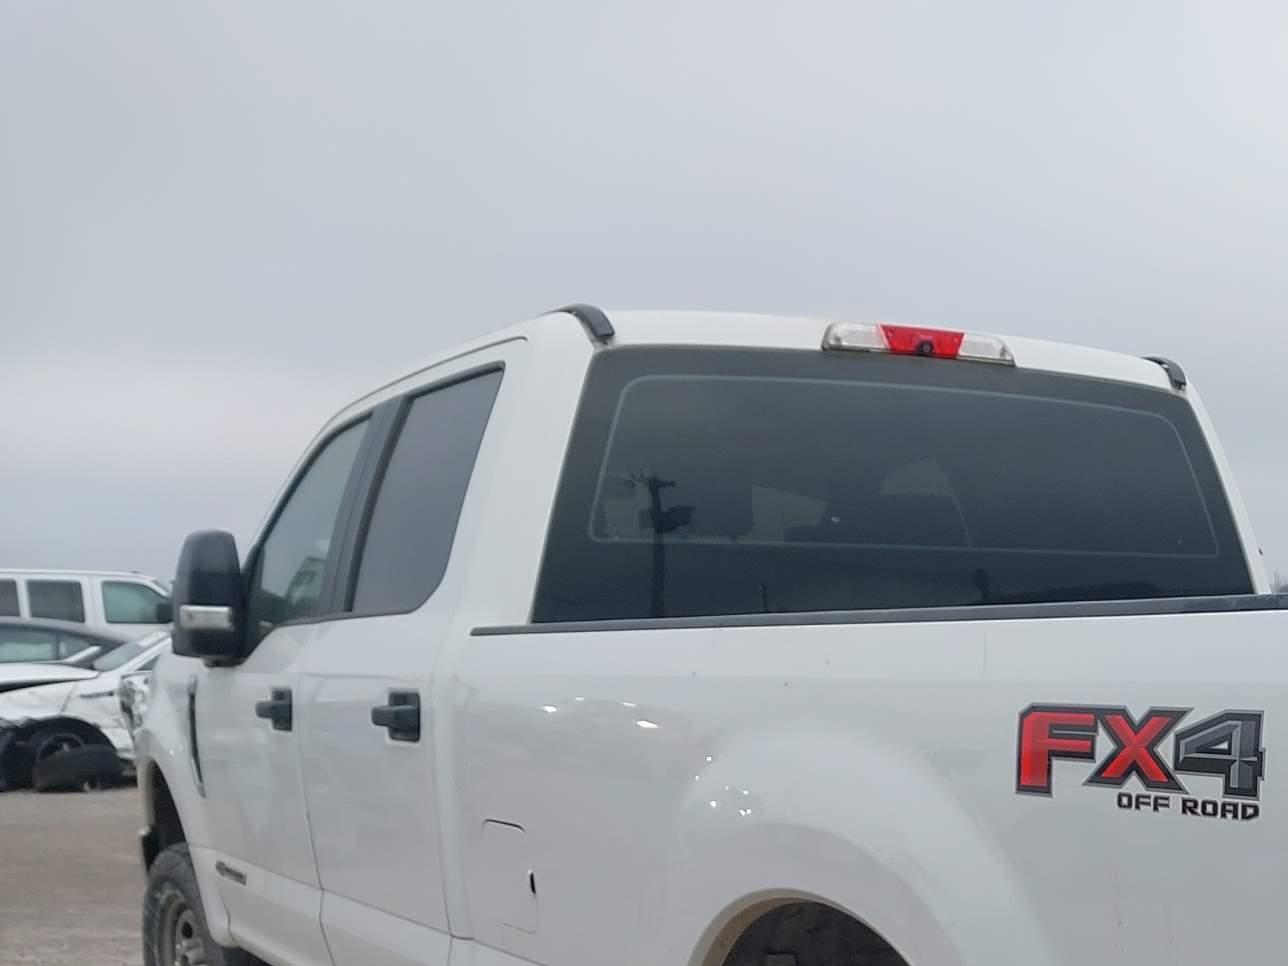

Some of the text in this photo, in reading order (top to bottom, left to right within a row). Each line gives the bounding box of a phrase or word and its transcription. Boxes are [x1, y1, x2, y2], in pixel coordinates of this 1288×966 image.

[1015, 702, 1266, 800] FX4
[1116, 792, 1260, 821] OFF ROAD
